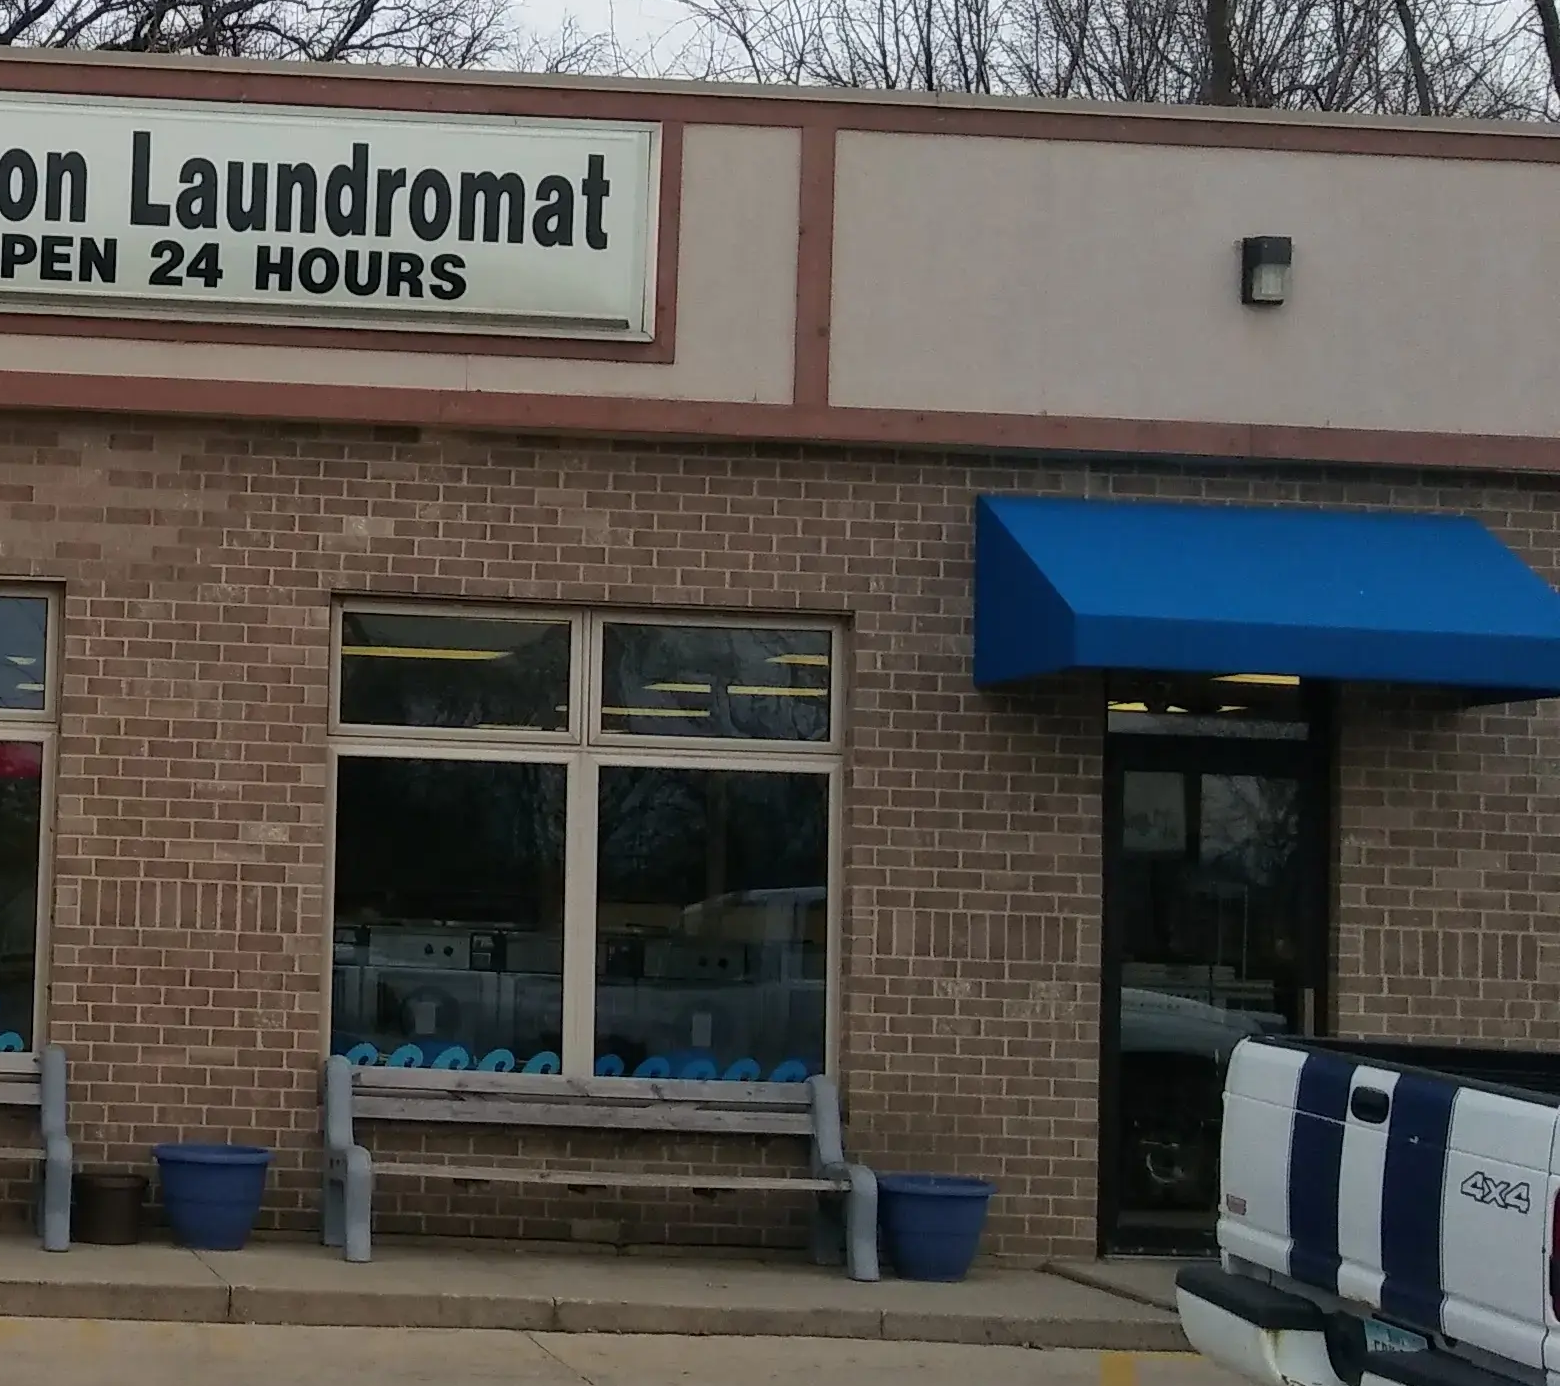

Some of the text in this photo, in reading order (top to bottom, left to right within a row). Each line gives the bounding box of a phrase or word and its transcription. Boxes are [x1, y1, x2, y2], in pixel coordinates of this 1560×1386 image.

[129, 130, 611, 251] Laundromat
[148, 239, 224, 289] 24
[254, 244, 467, 301] HOURS
